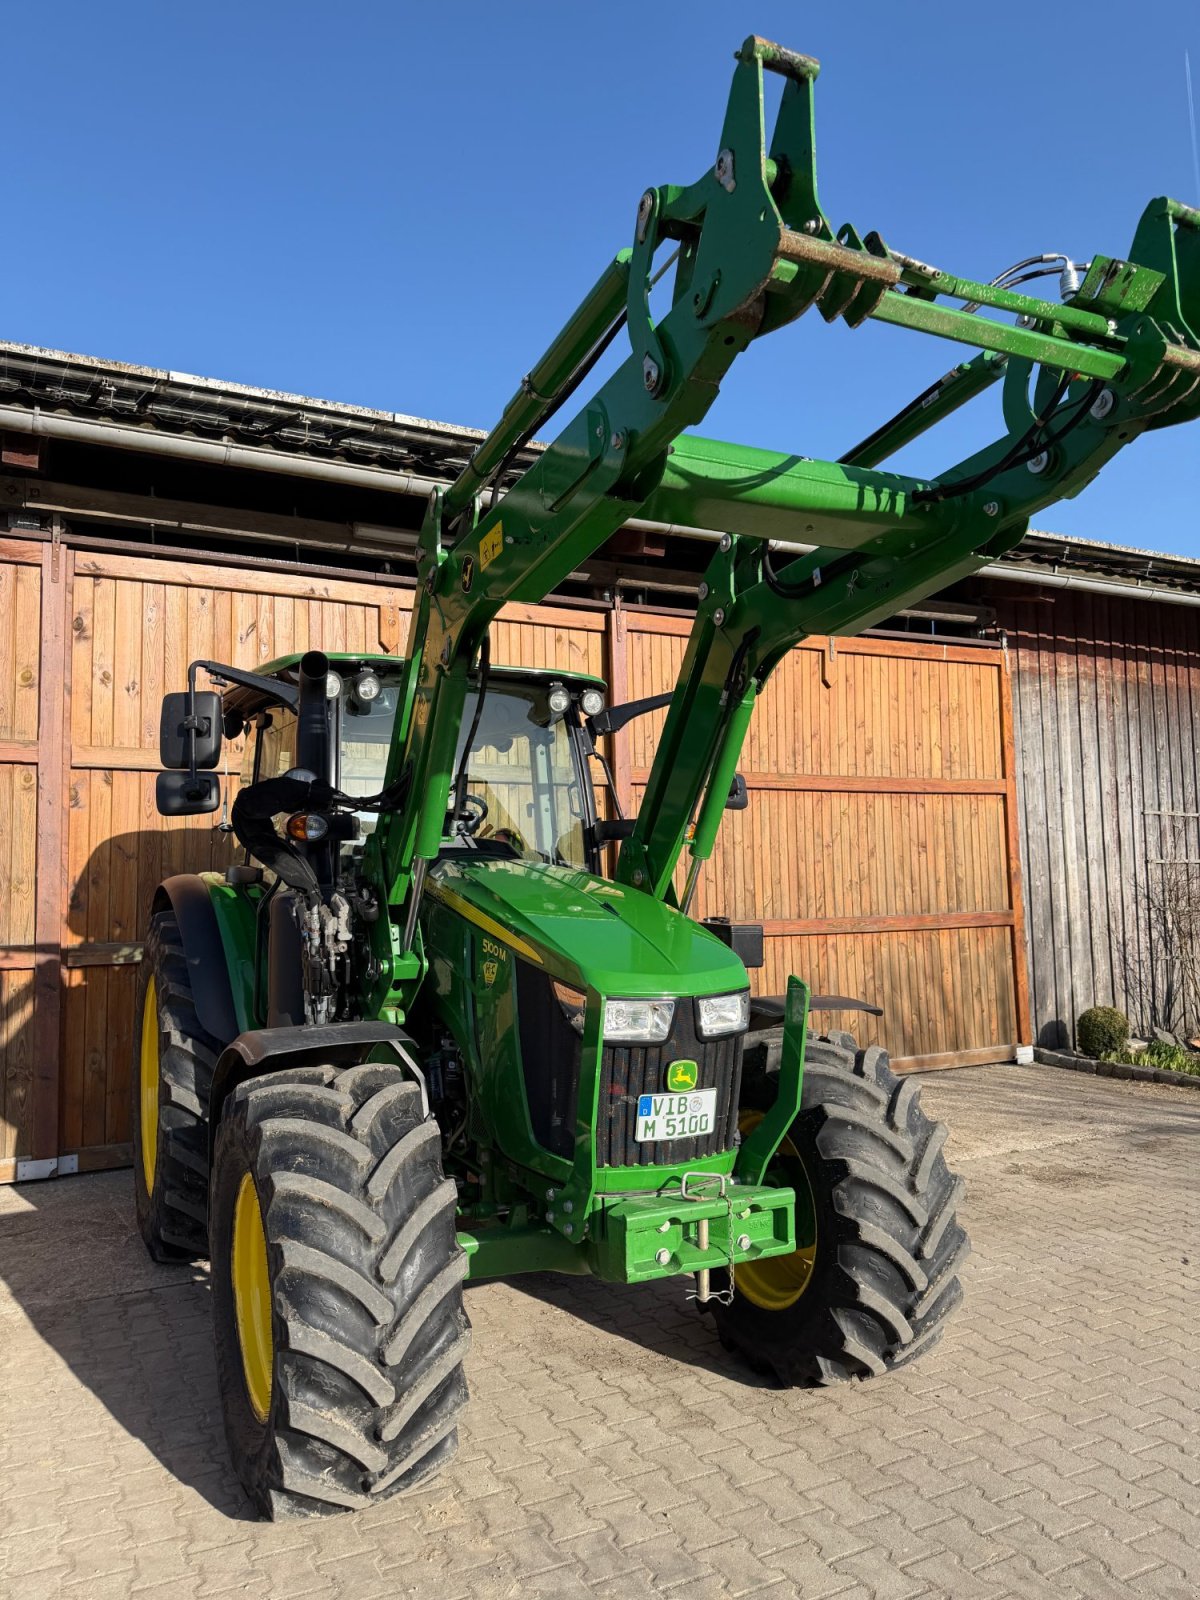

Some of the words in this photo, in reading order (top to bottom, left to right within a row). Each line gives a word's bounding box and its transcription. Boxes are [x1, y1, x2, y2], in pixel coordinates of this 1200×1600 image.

[653, 1096, 688, 1117] VIB
[643, 1119, 656, 1138] M
[665, 1113, 709, 1137] 5100
